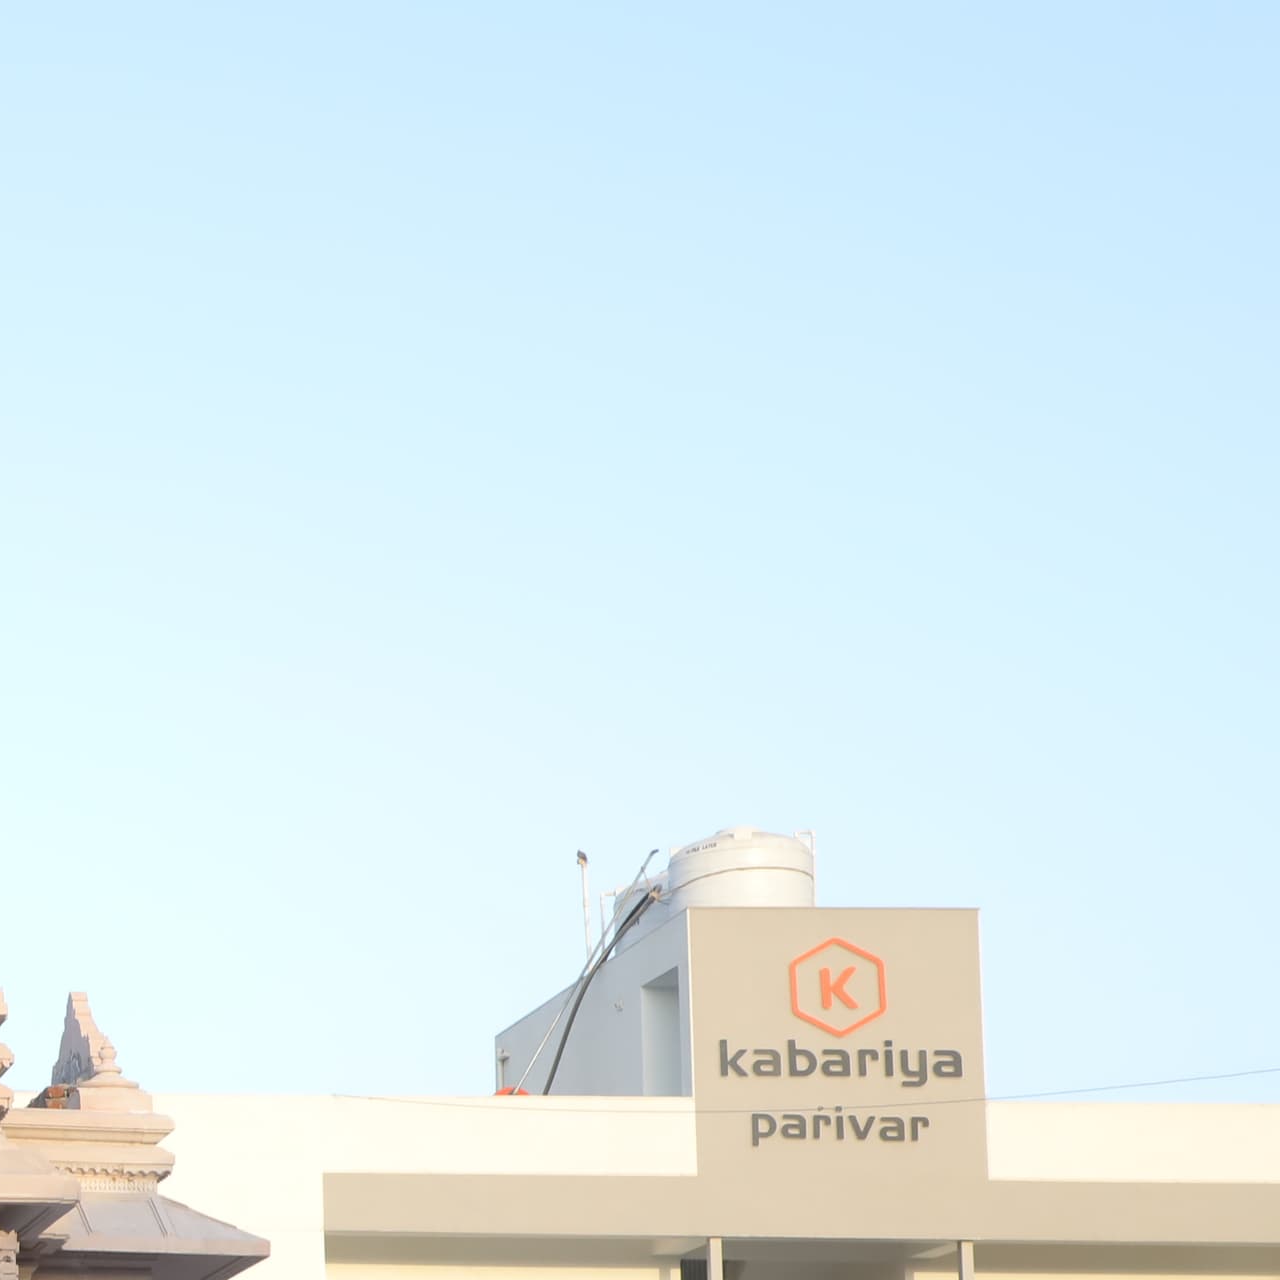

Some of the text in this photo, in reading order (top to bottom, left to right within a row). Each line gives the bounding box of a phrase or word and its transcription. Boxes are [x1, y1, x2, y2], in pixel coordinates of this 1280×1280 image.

[820, 966, 858, 1009] K
[719, 1039, 963, 1087] kabariya
[751, 1106, 930, 1147] parivar
